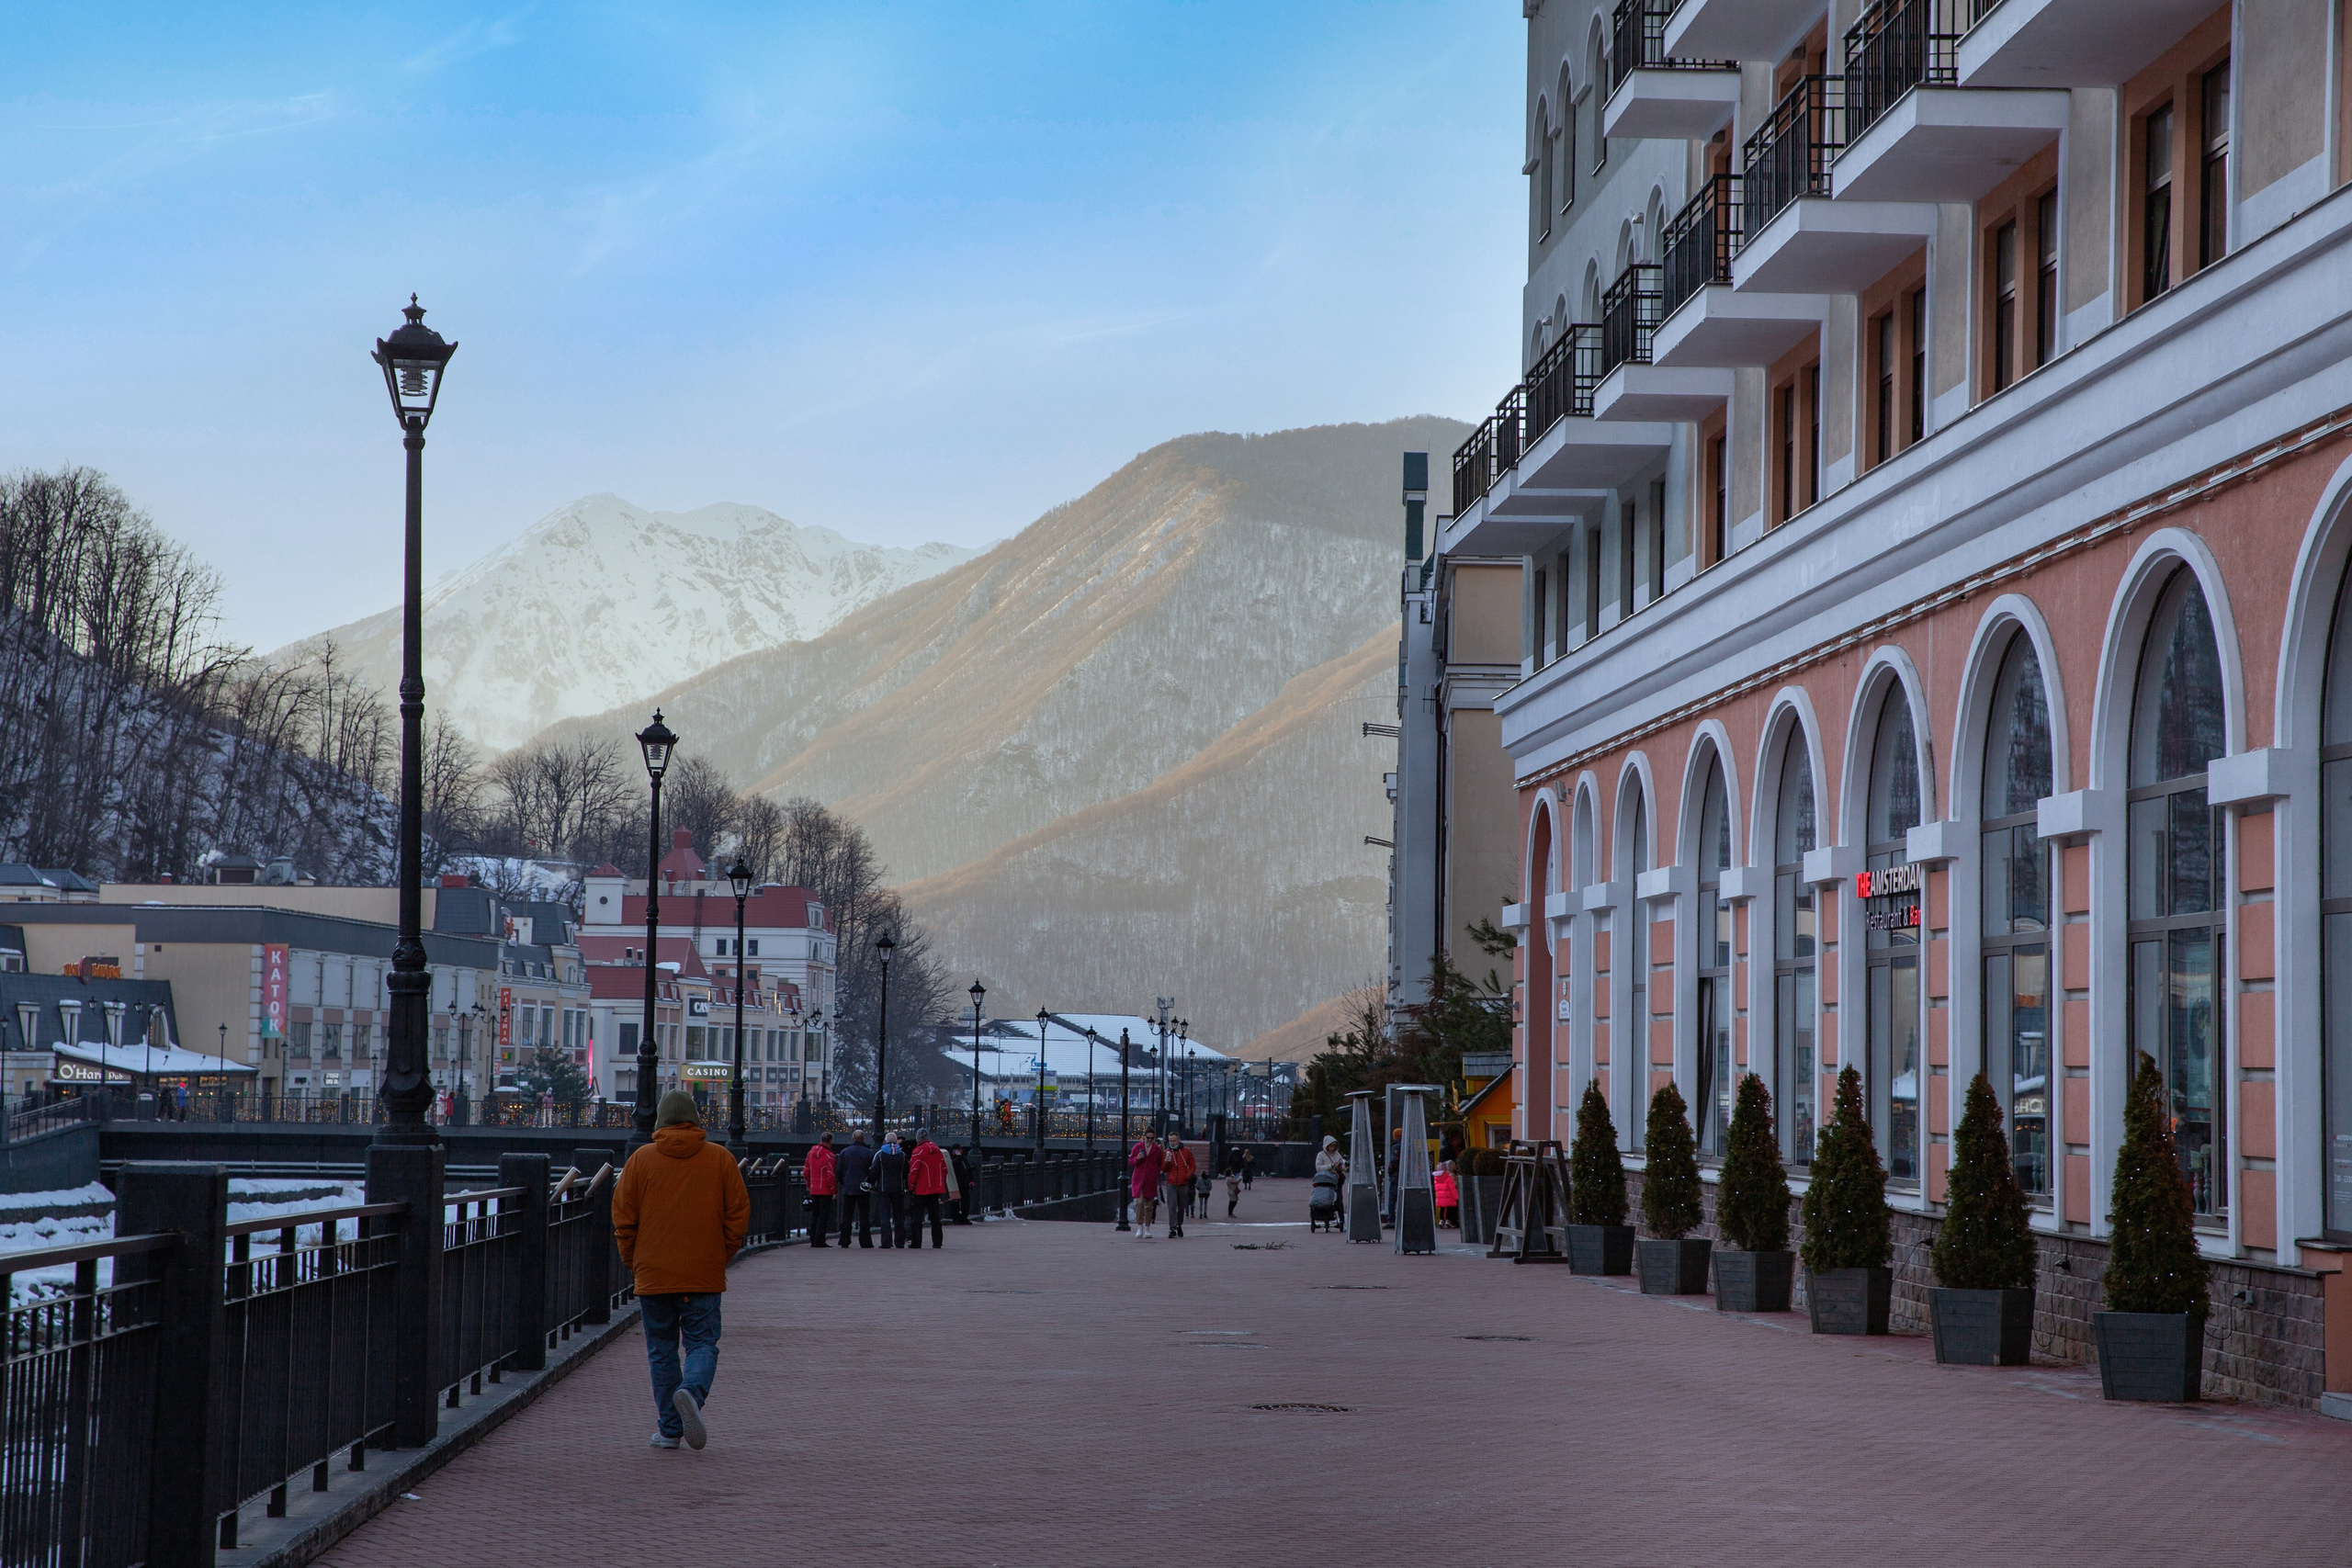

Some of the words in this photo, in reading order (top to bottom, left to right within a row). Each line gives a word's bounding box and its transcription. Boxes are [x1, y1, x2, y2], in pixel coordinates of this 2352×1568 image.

[1856, 872, 1871, 898] THE
[1866, 908, 1902, 931] Restaurant
[1903, 906, 1908, 927] &
[1909, 905, 1921, 926] Bar
[269, 950, 281, 1032] КАТОК
[501, 990, 509, 1043] PIERIA
[108, 1071, 124, 1080] Pub
[687, 1067, 728, 1077] CASINO
